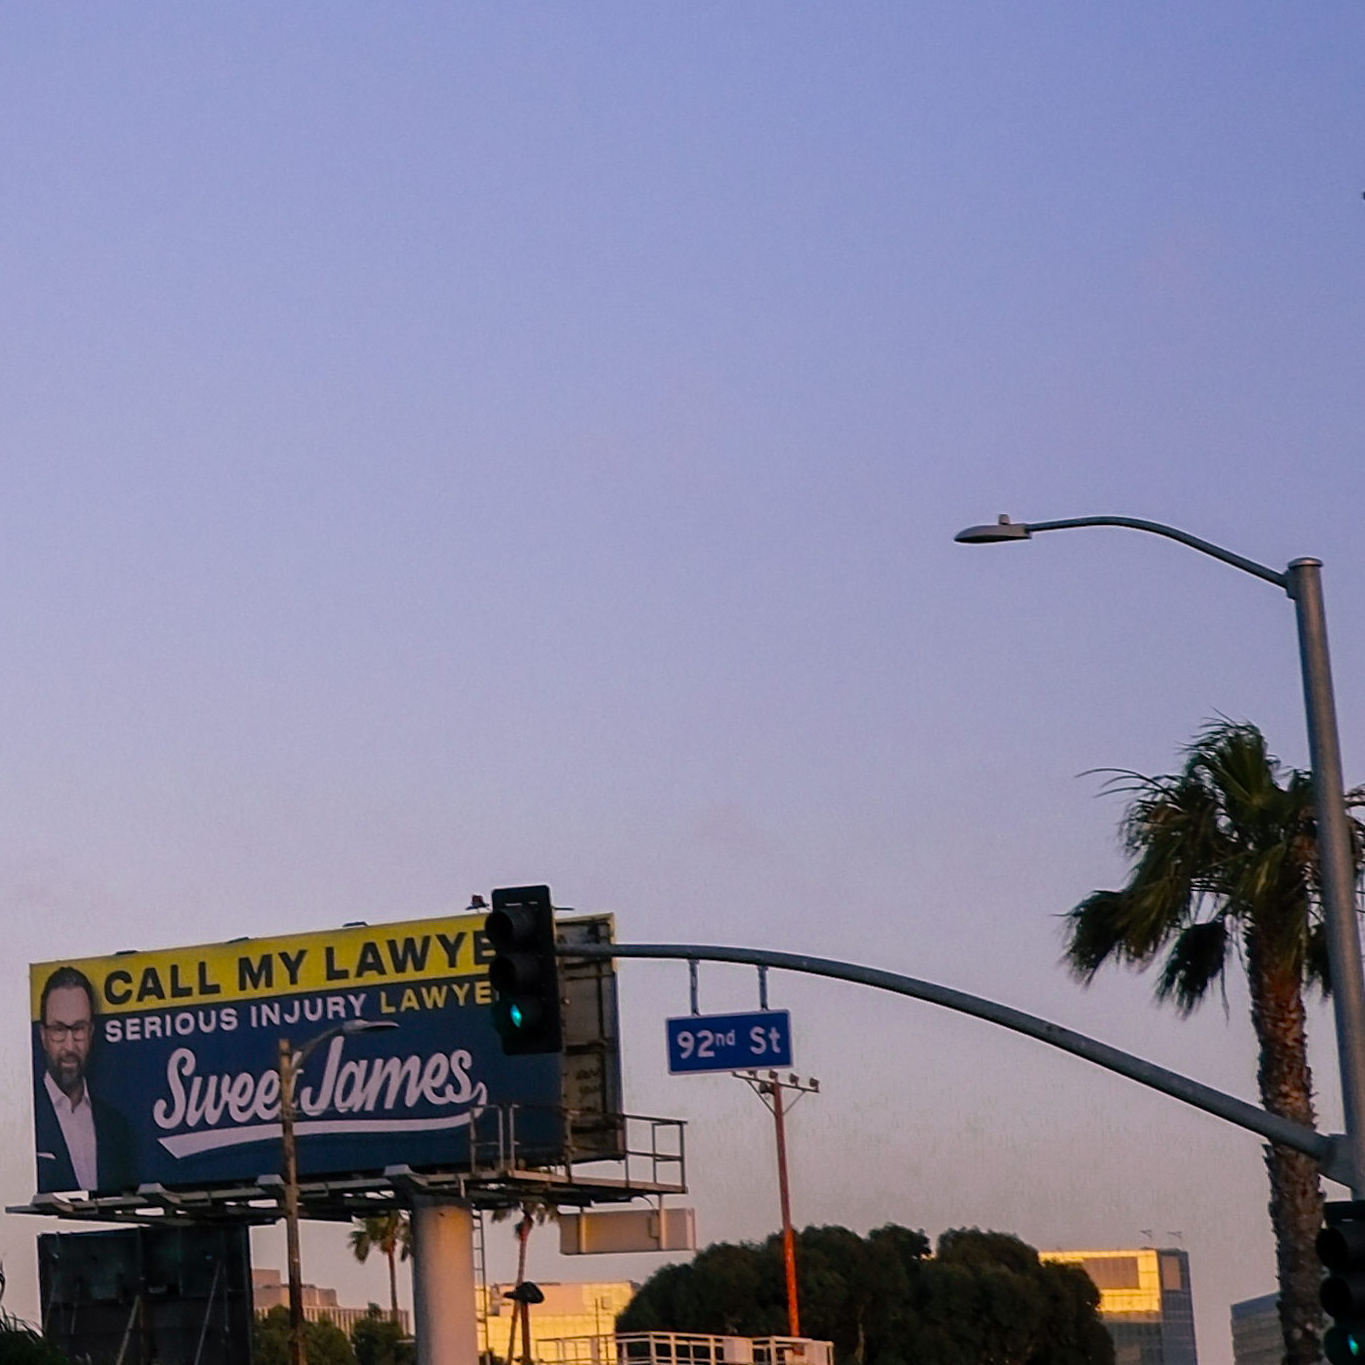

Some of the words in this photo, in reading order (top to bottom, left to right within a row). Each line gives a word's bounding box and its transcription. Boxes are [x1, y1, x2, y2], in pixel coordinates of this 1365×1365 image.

[103, 961, 221, 1005] CALL
[238, 948, 308, 992] MY
[325, 929, 498, 982] LAWYE
[105, 1007, 238, 1043] SERIOUS
[250, 994, 367, 1028] INJURY
[380, 980, 498, 1014] LAWYE
[677, 1029, 736, 1059] 92nd
[750, 1026, 781, 1055] St
[300, 1036, 483, 1117] James
